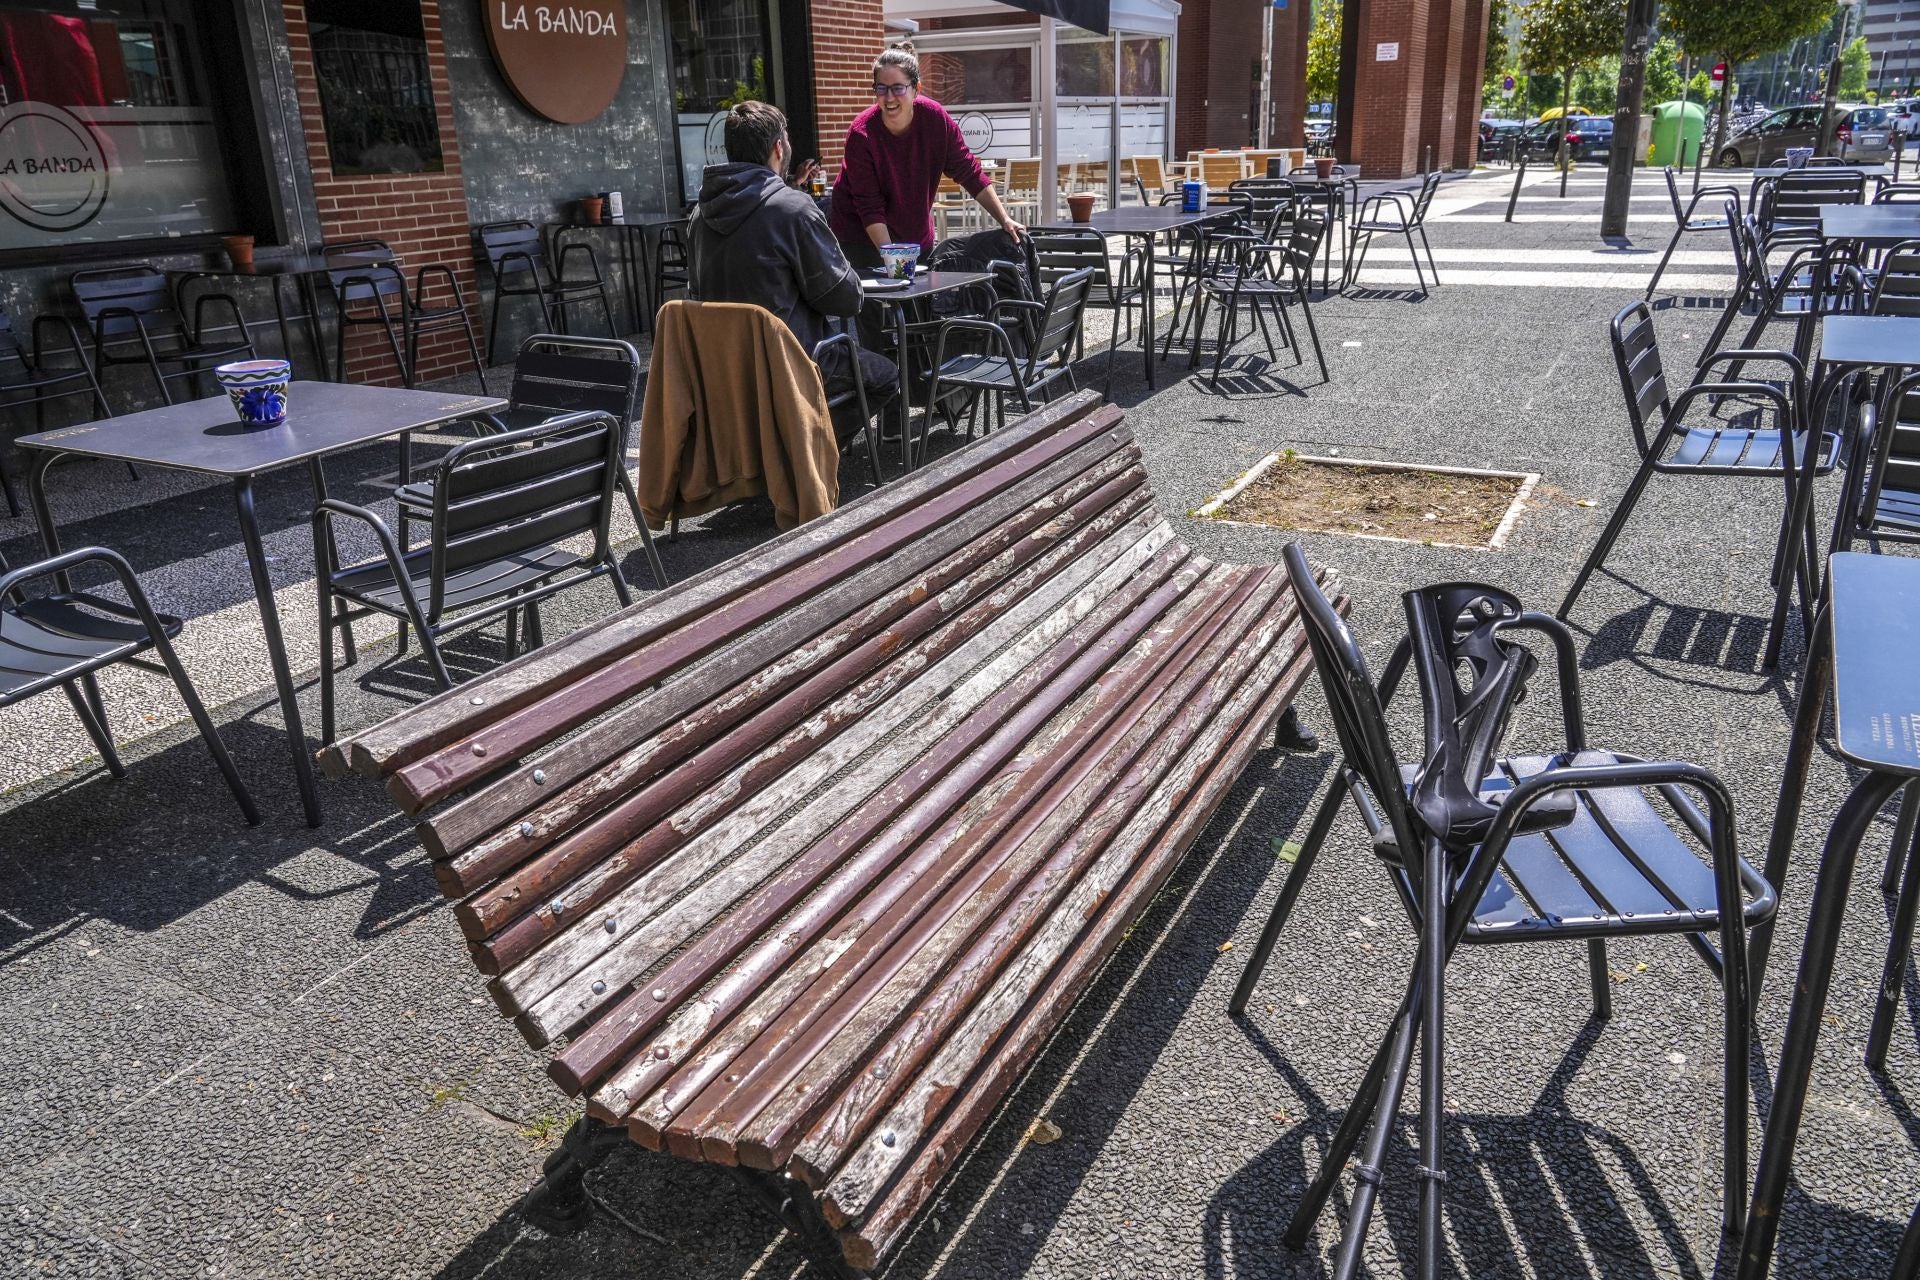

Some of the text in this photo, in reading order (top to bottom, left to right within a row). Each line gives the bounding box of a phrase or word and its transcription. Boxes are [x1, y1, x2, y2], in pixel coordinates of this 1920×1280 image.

[501, 1, 618, 36] LA BANDA
[23, 157, 97, 175] BANDA
